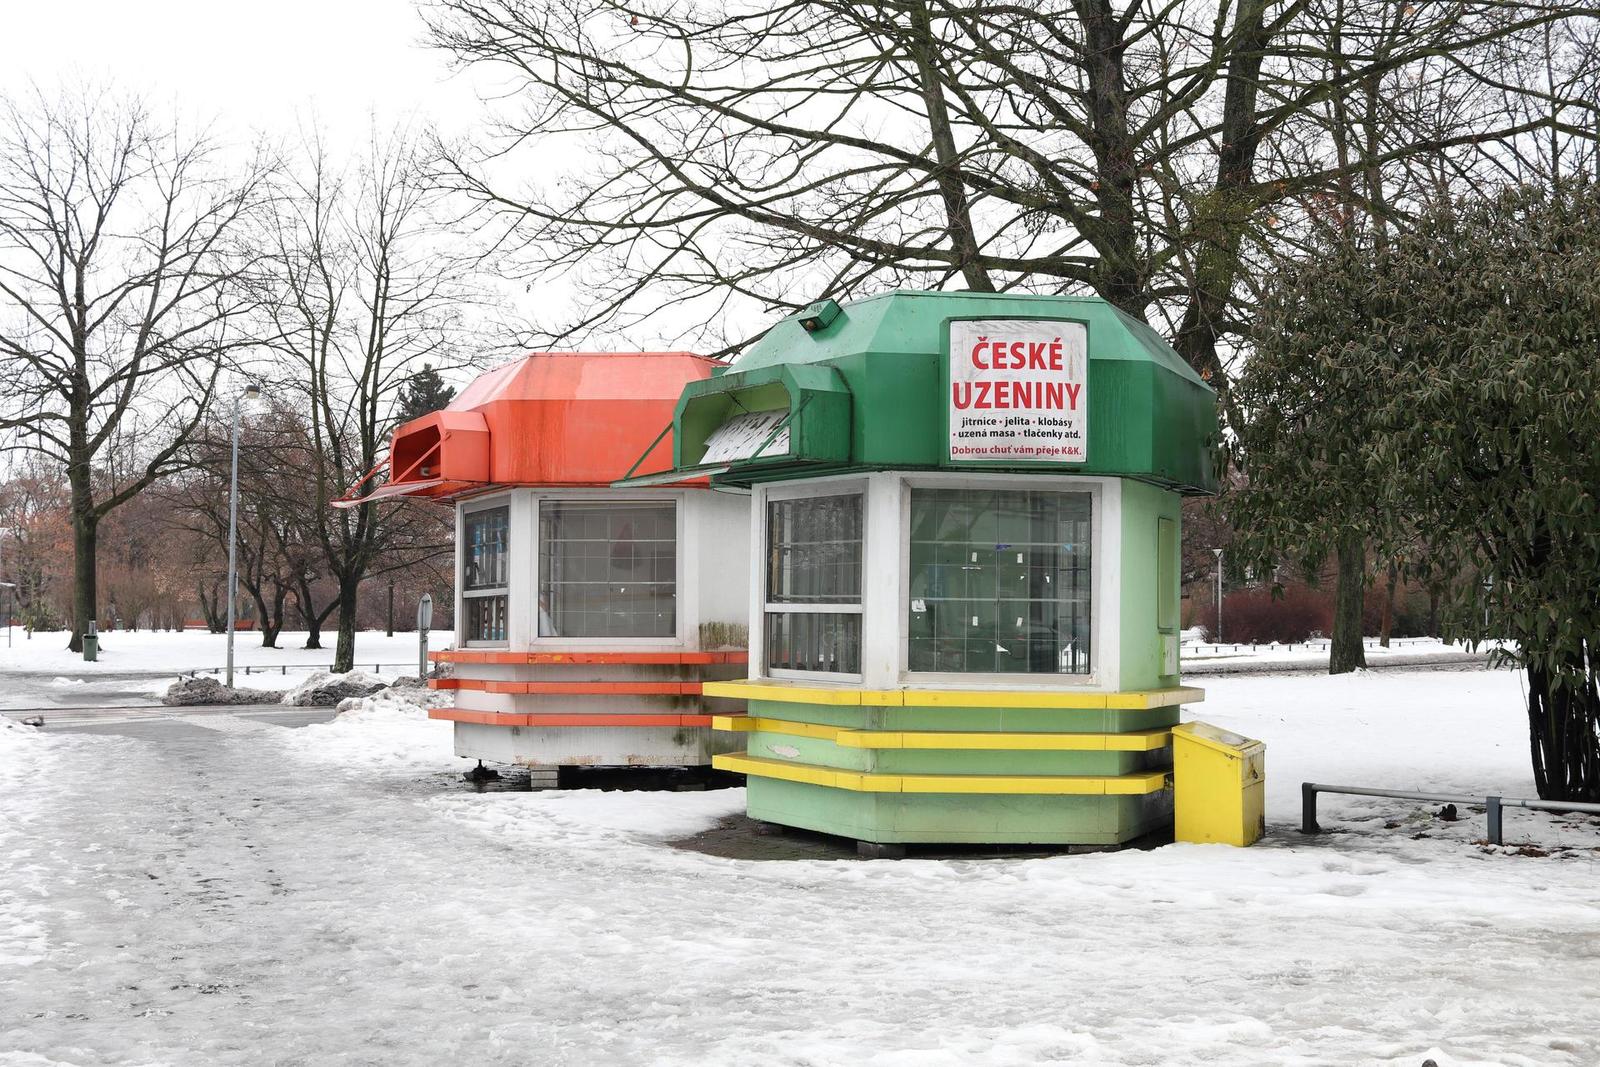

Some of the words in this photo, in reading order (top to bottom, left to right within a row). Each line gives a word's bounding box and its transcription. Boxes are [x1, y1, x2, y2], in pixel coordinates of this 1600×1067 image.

[972, 336, 1063, 371] ČESKÉ
[953, 381, 1082, 411] UZENINY
[961, 417, 997, 428] jitrnice
[1004, 417, 1030, 428] jelita
[1038, 417, 1073, 428] klobásy
[958, 429, 987, 438] uzená
[989, 430, 1015, 438] masa
[1023, 429, 1063, 440] tlačenky
[1064, 430, 1081, 439] atd.
[952, 446, 988, 455] Dobrou
[989, 444, 1013, 454] chuť
[1014, 445, 1034, 454] vám
[1036, 445, 1060, 456] přeje
[1061, 446, 1082, 456] K&K.
